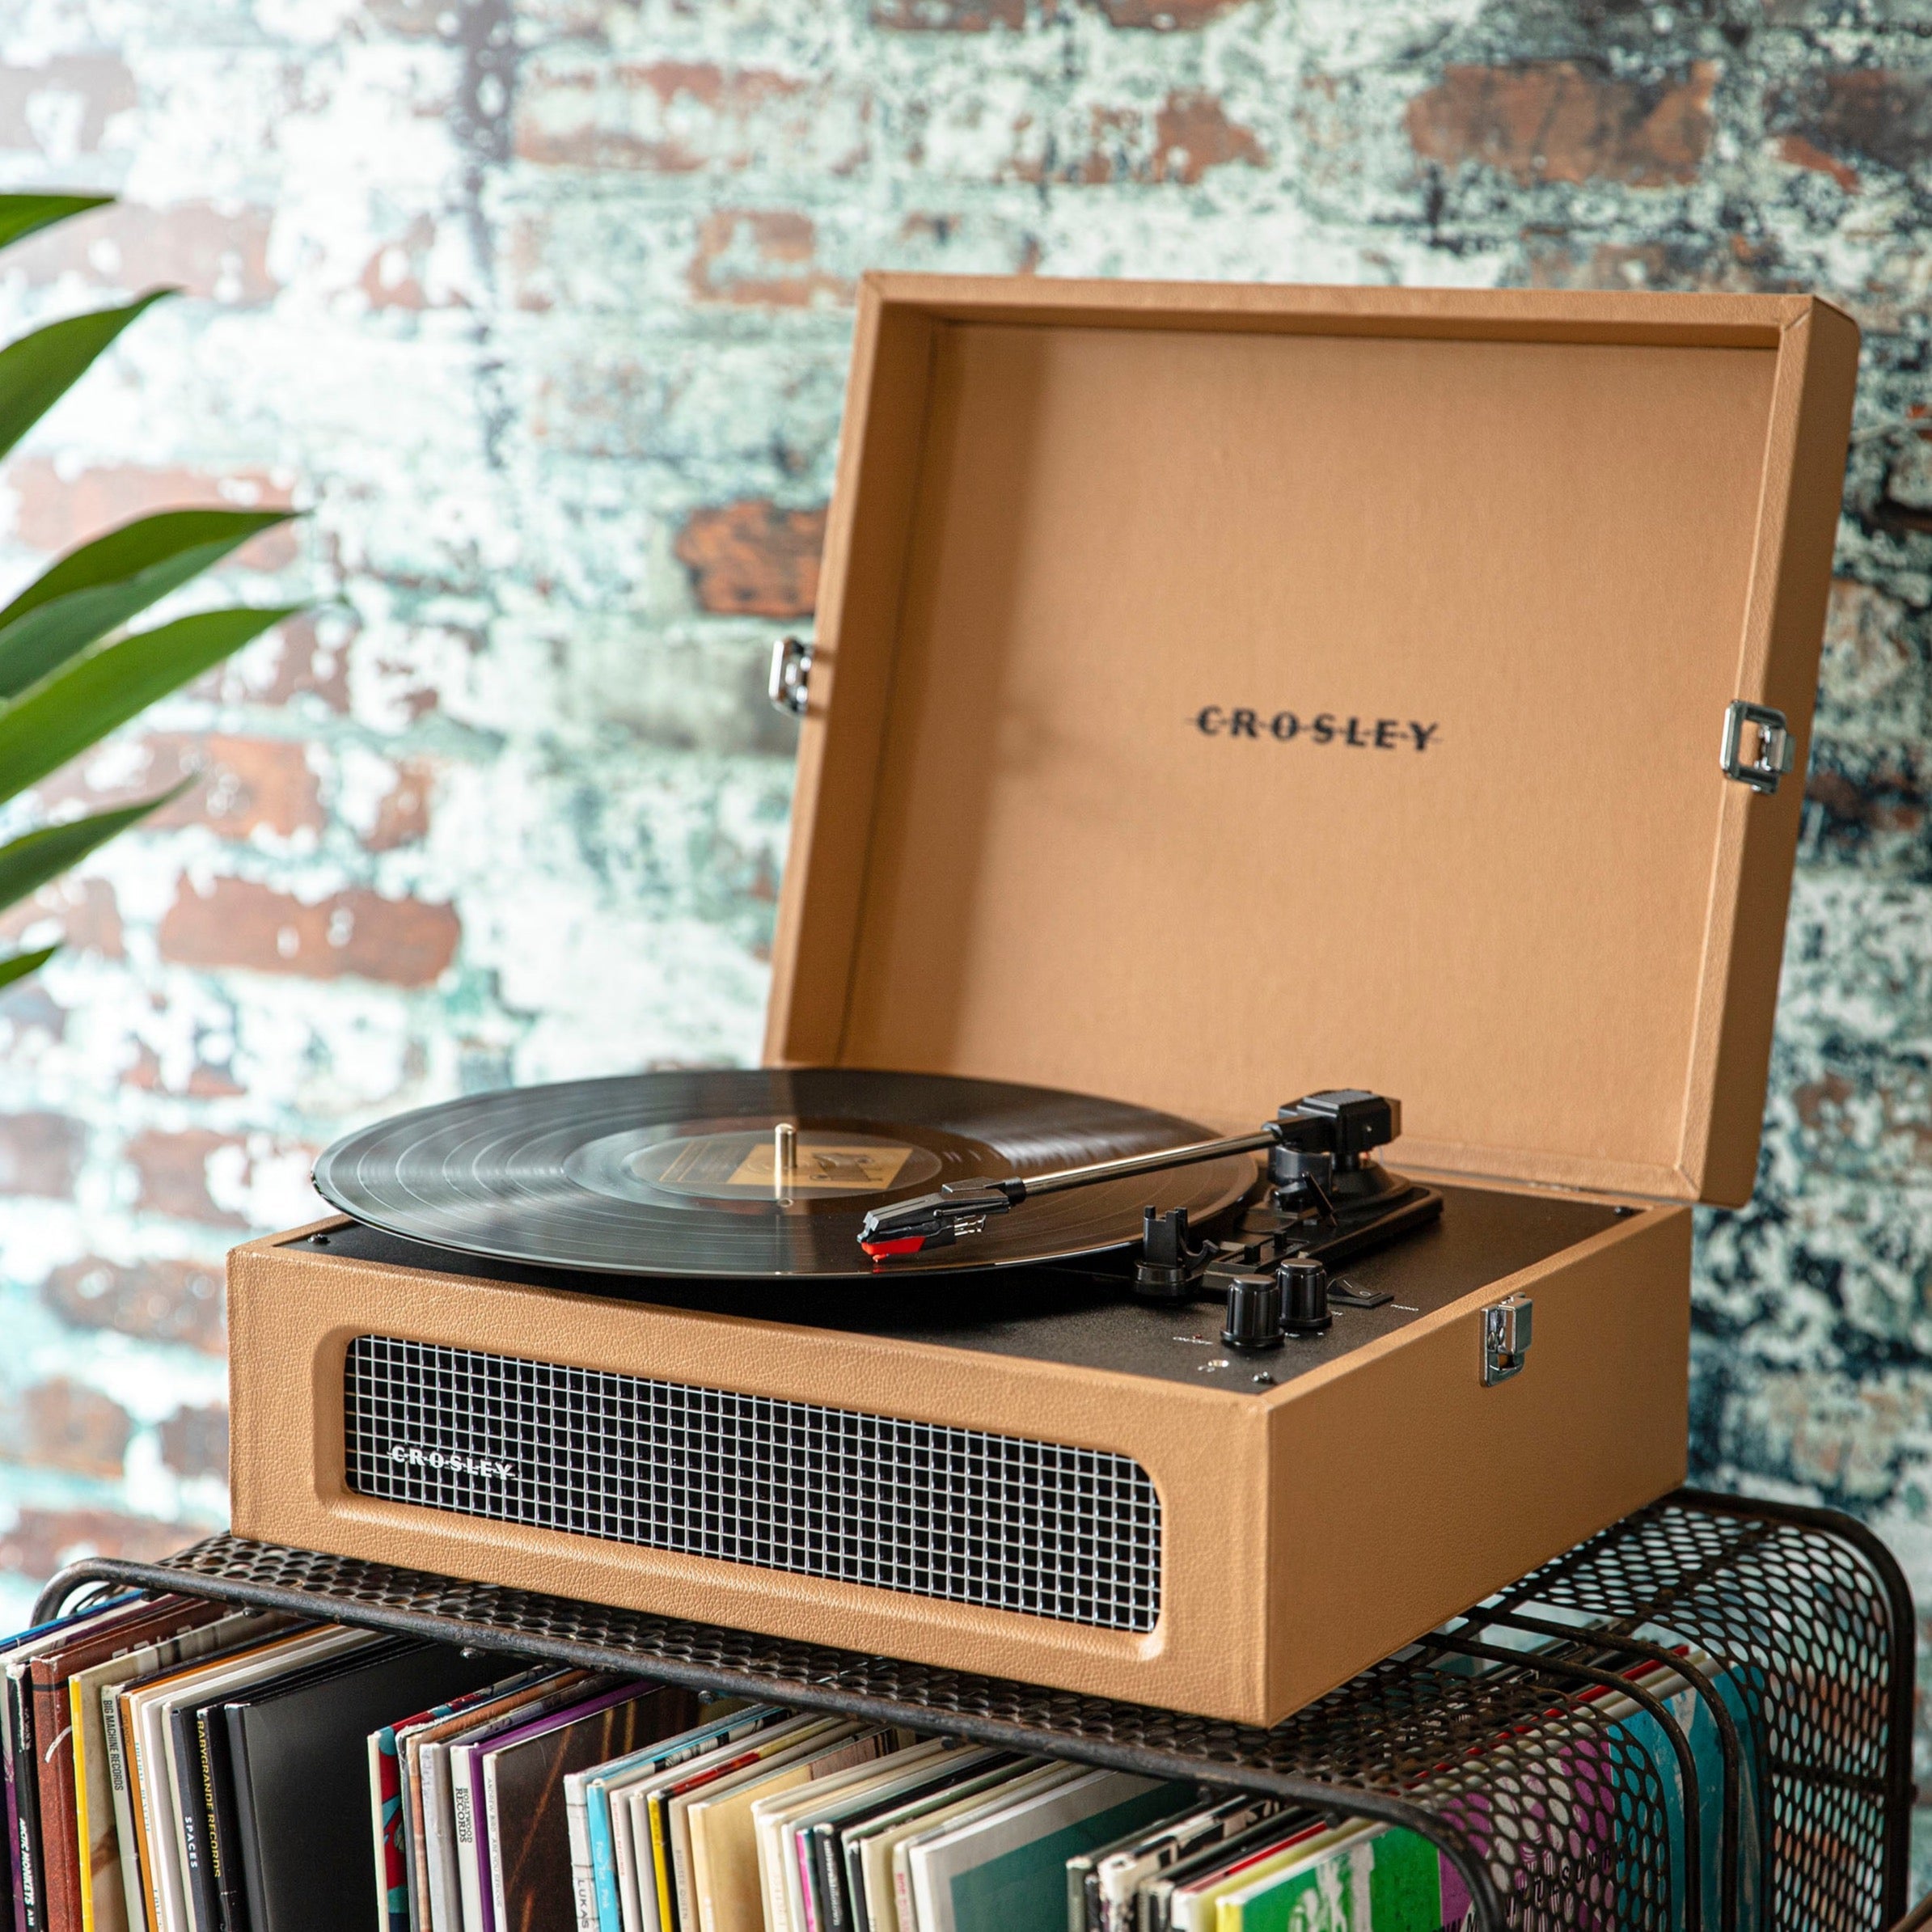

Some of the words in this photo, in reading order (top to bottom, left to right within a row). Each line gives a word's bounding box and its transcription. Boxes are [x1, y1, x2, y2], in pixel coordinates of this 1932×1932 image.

[1194, 704, 1439, 751] CROSLEY
[390, 1444, 514, 1481] CROSLEY
[103, 1699, 114, 1714] BIG
[105, 1715, 119, 1752] MACHINE
[110, 1752, 125, 1791] RECORDS
[455, 1787, 467, 1844] RECORDS
[184, 1816, 198, 1869] SPACES
[577, 1879, 590, 1929] LUKAS
